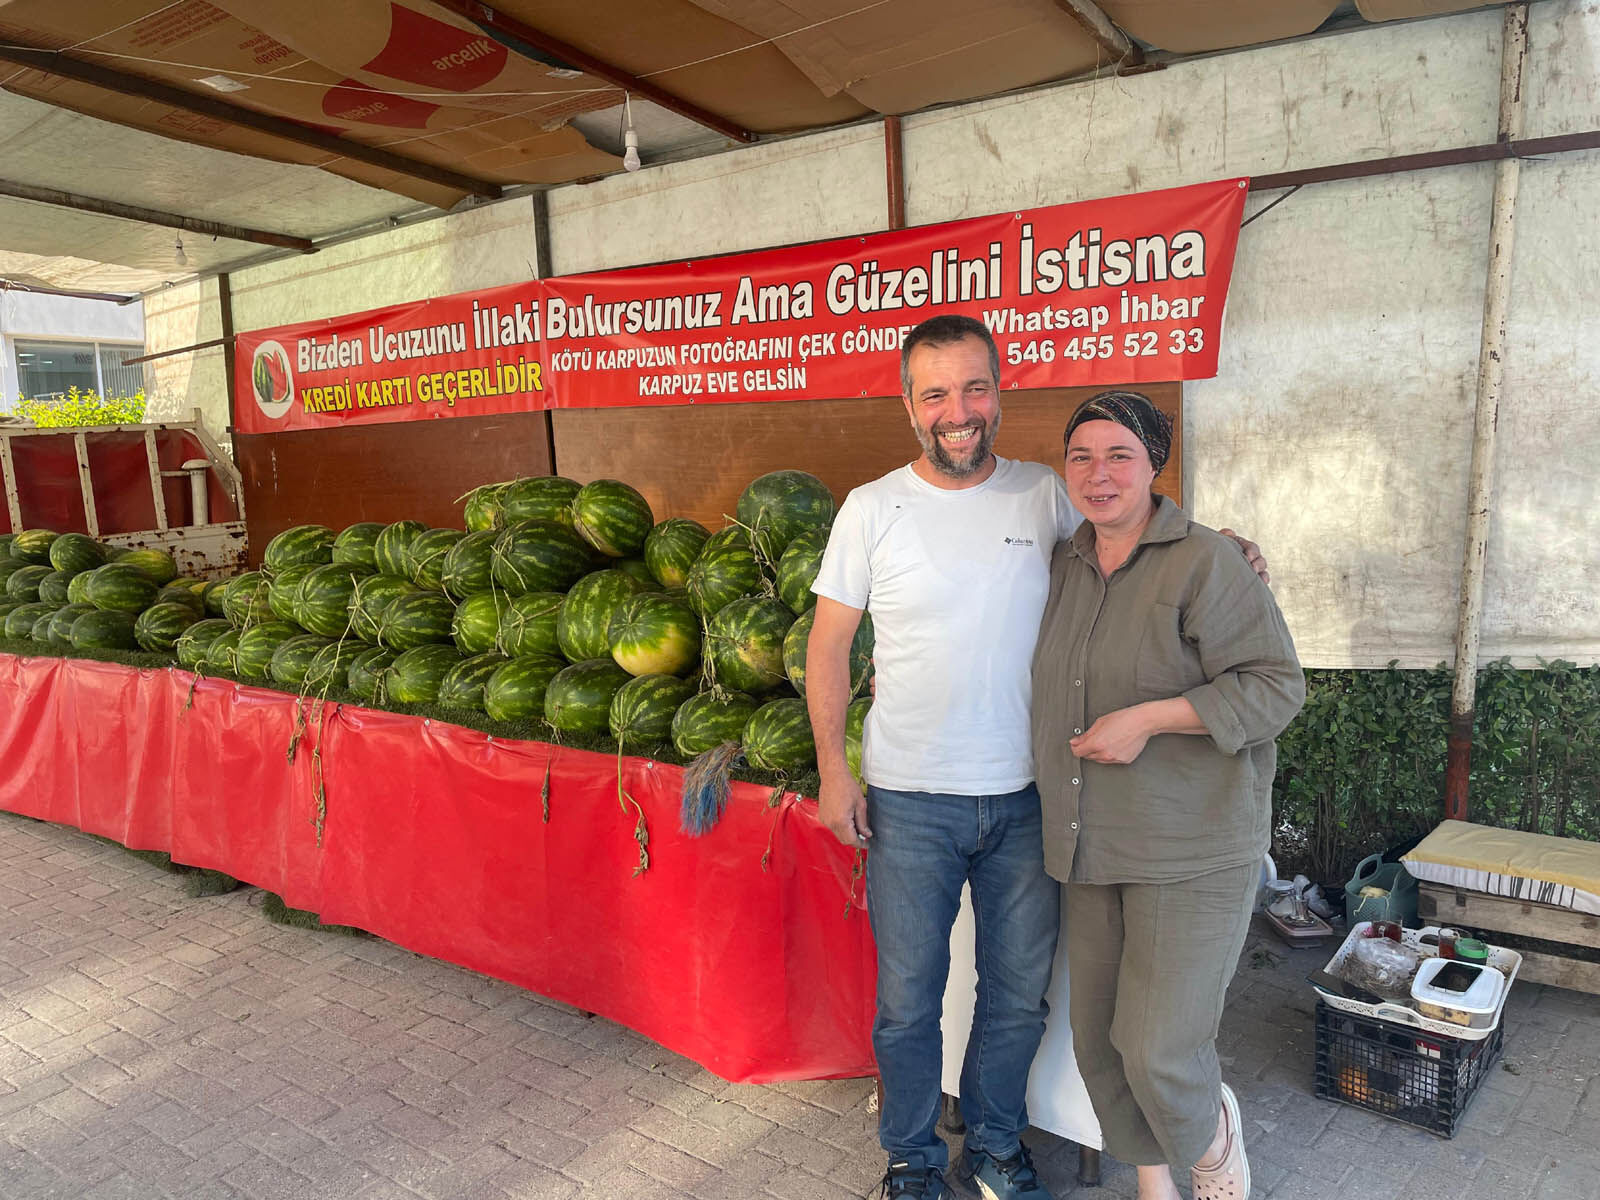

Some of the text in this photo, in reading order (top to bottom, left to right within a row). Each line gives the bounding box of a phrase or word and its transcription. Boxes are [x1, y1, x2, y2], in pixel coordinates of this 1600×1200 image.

[297, 223, 1206, 373] Bizden Ucuzunu İllaki Bulursunuz Ama Güzelini İstisna
[982, 290, 1205, 335] Whatsap İhbar
[551, 324, 918, 372] KÖTÜ KARPUZUN FOTOĞRAFINI ÇEK GÖNDE
[1007, 327, 1205, 365] 546 455 52 33
[301, 356, 543, 414] KREDİ KARTI GEÇERLİDİR
[639, 362, 808, 396] KARPUZ EVE GELSİN
